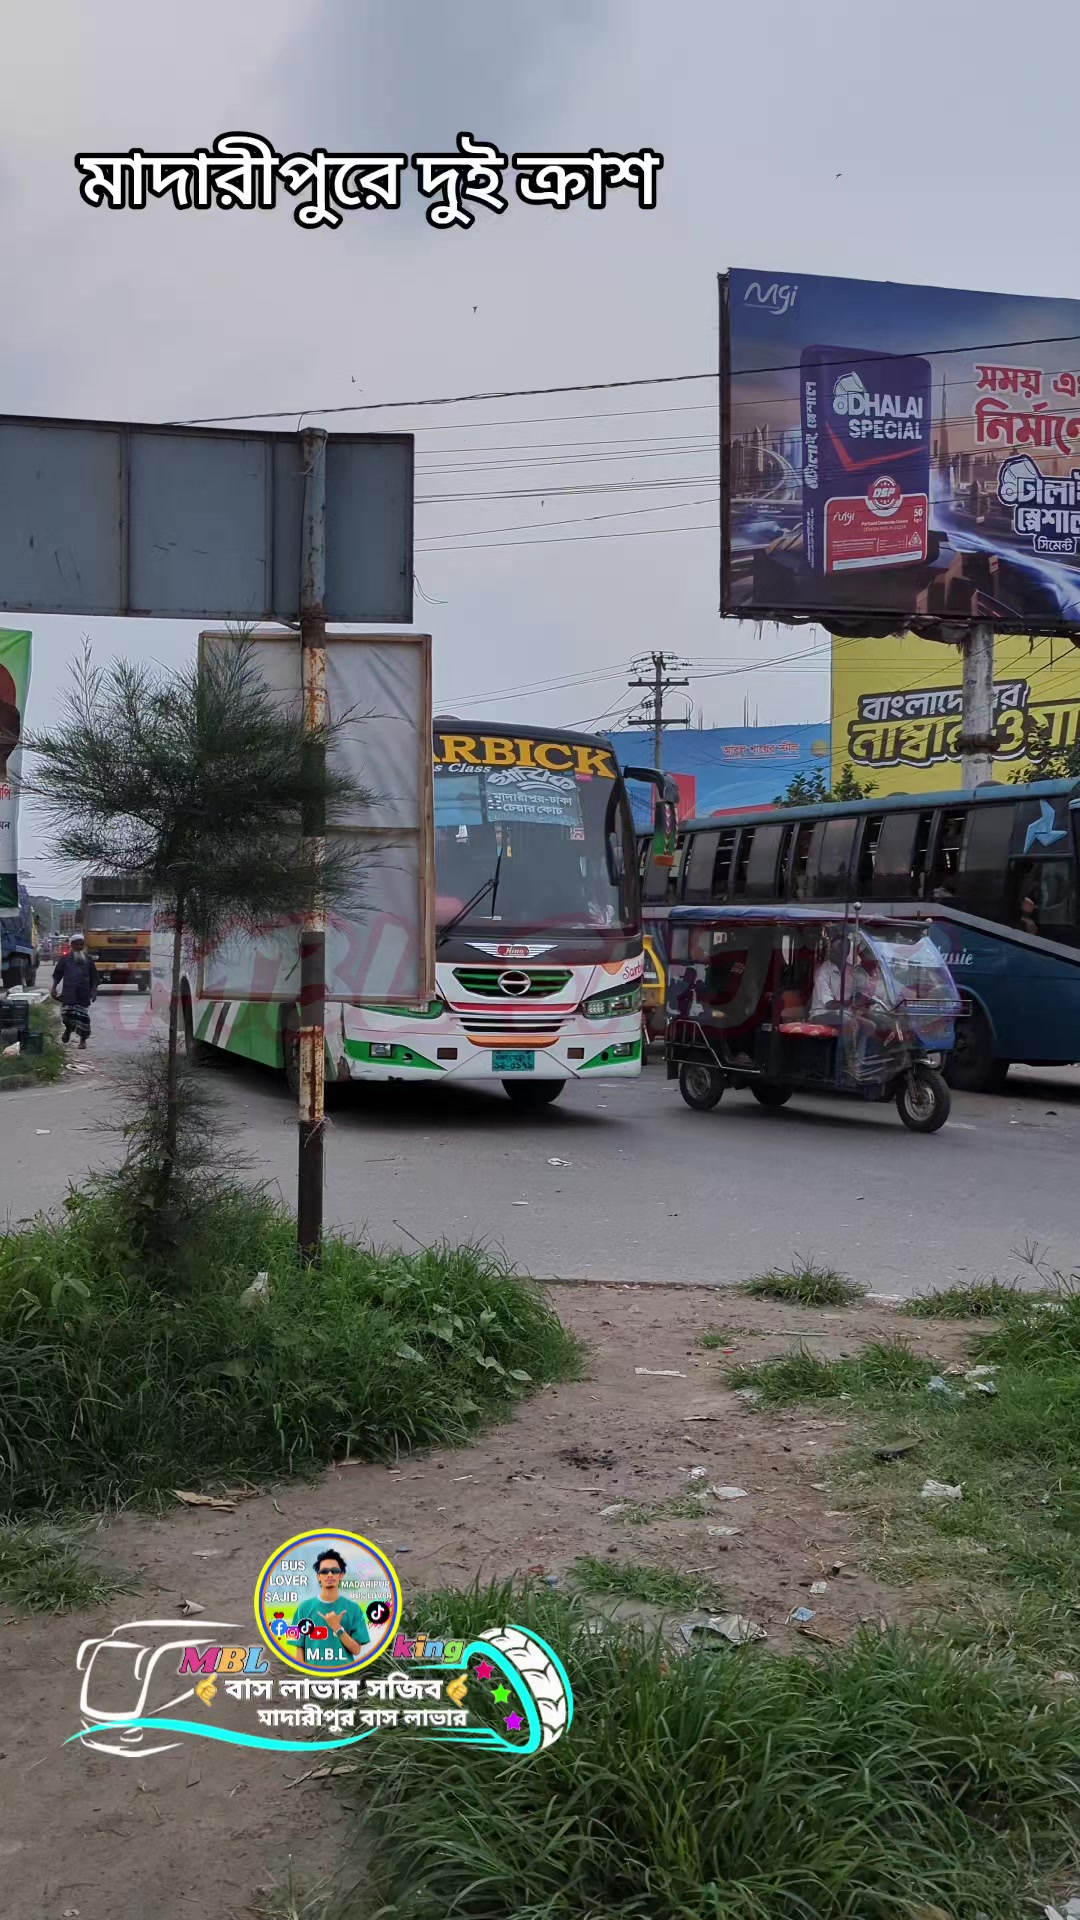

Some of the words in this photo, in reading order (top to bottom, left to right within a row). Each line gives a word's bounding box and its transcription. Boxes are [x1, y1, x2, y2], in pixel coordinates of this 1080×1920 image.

[976, 366, 1041, 398] সময়
[1053, 373, 1080, 397] এ
[848, 393, 922, 418] DHALAI
[849, 419, 922, 440] SPECIAL
[1038, 537, 1073, 551] সিমেন্ট
[432, 735, 617, 779] RBICK
[448, 763, 492, 773] Class
[503, 803, 535, 814] চেয়ার
[537, 804, 563, 815] কোচ
[504, 947, 524, 956] Hino
